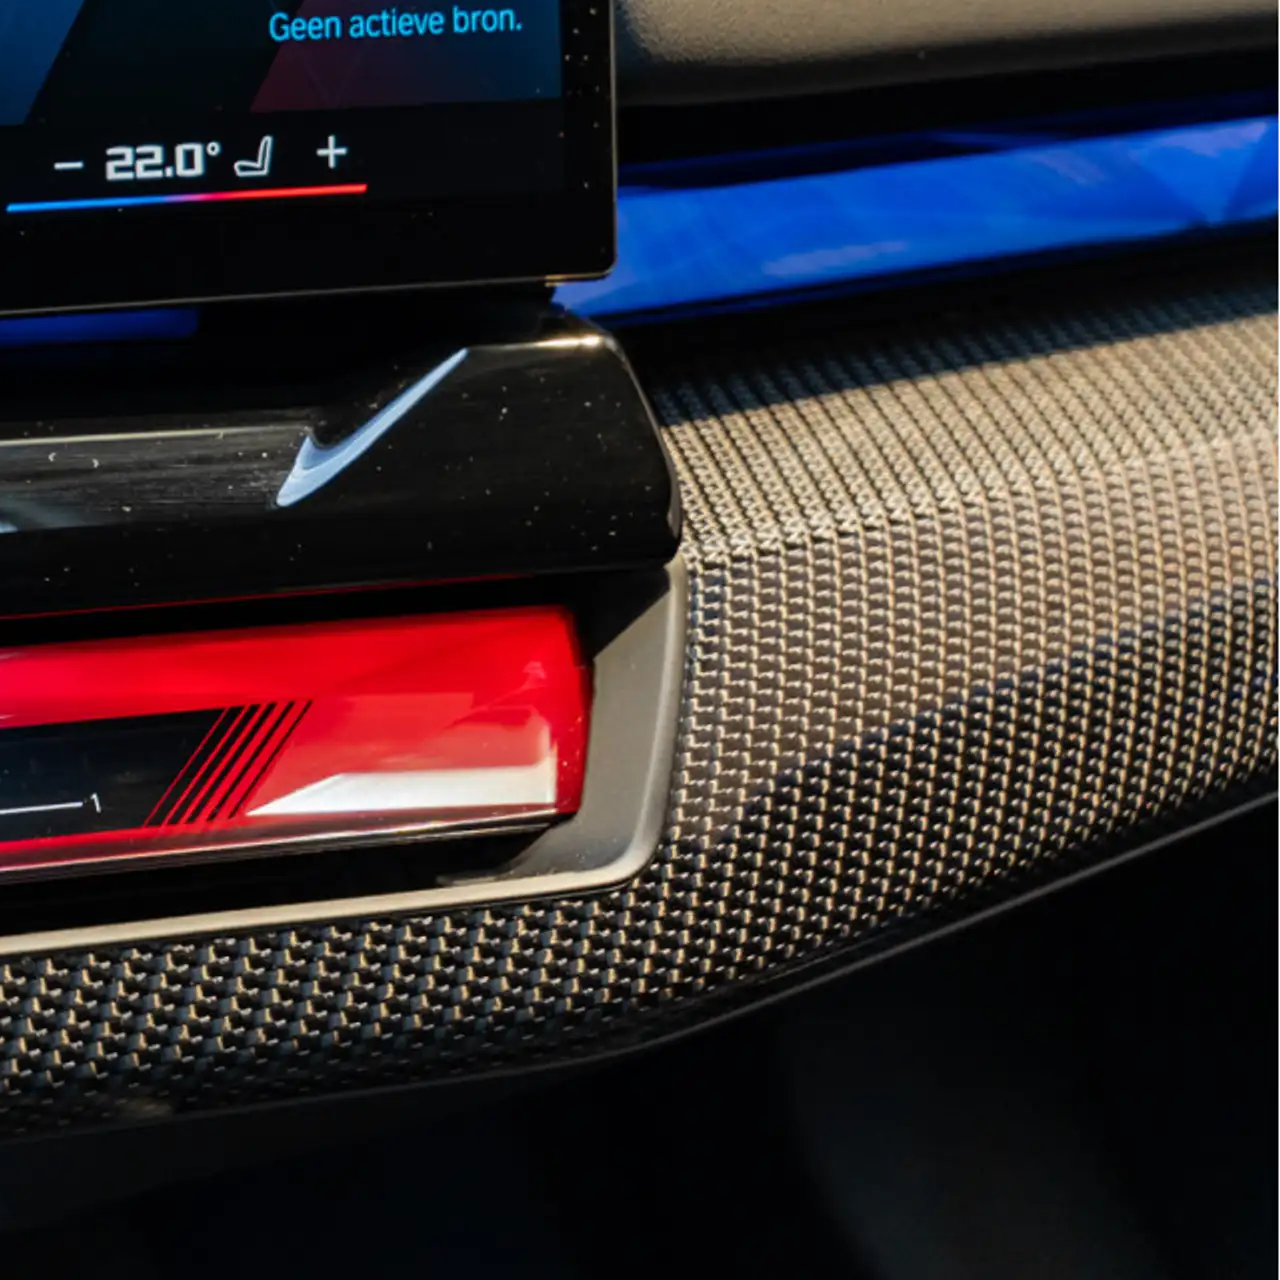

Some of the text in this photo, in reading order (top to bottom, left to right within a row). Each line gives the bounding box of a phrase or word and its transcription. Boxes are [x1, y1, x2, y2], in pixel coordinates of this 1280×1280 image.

[269, 5, 523, 42] Geen actieve bron.
[105, 142, 221, 181] 22.0°
[91, 792, 102, 815] 1
